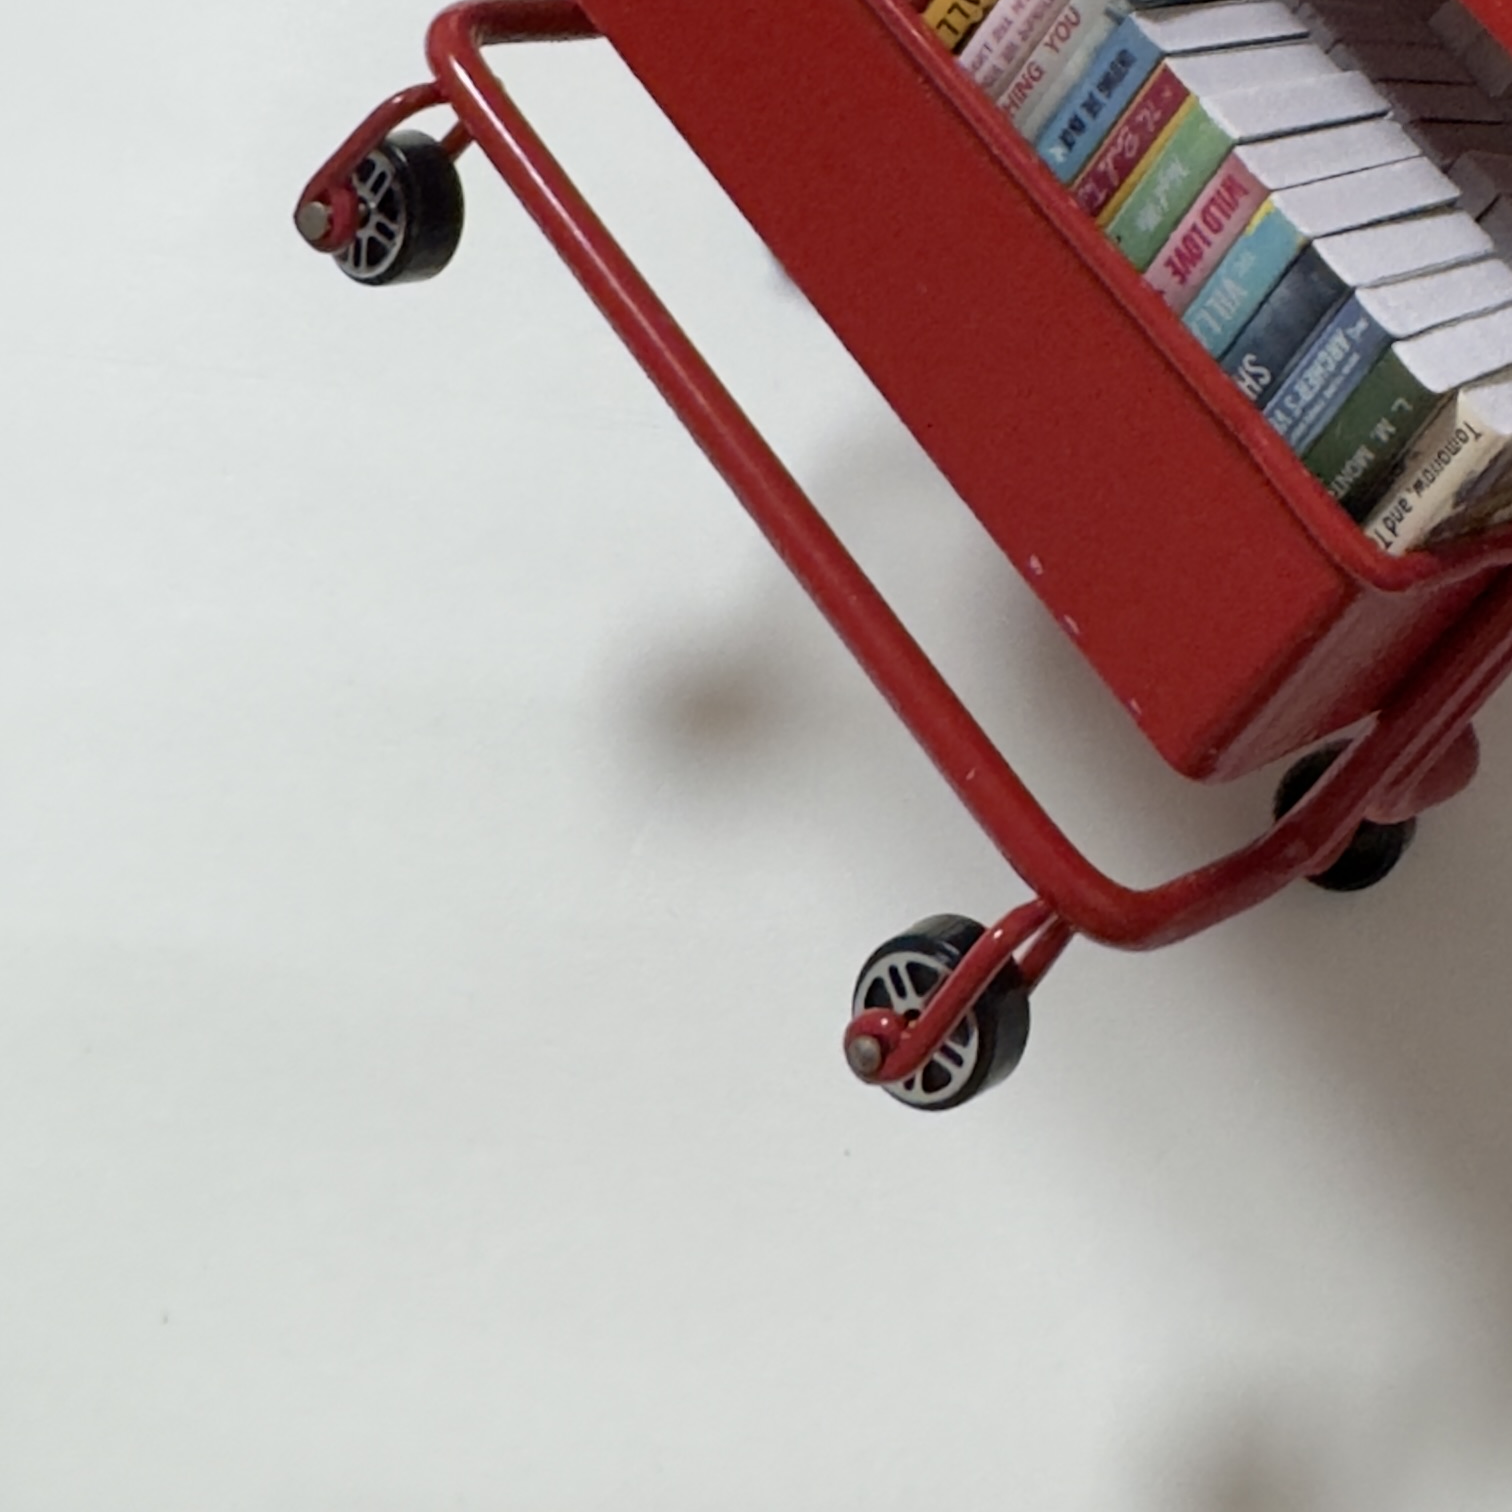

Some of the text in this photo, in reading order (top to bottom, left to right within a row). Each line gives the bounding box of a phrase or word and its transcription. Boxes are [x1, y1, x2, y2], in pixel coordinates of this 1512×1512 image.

[1042, 4, 1086, 55] YOU
[1194, 172, 1252, 236] WILD
[1158, 221, 1217, 287] LOVE
[1225, 350, 1277, 403] SH
[1378, 495, 1415, 538] and
